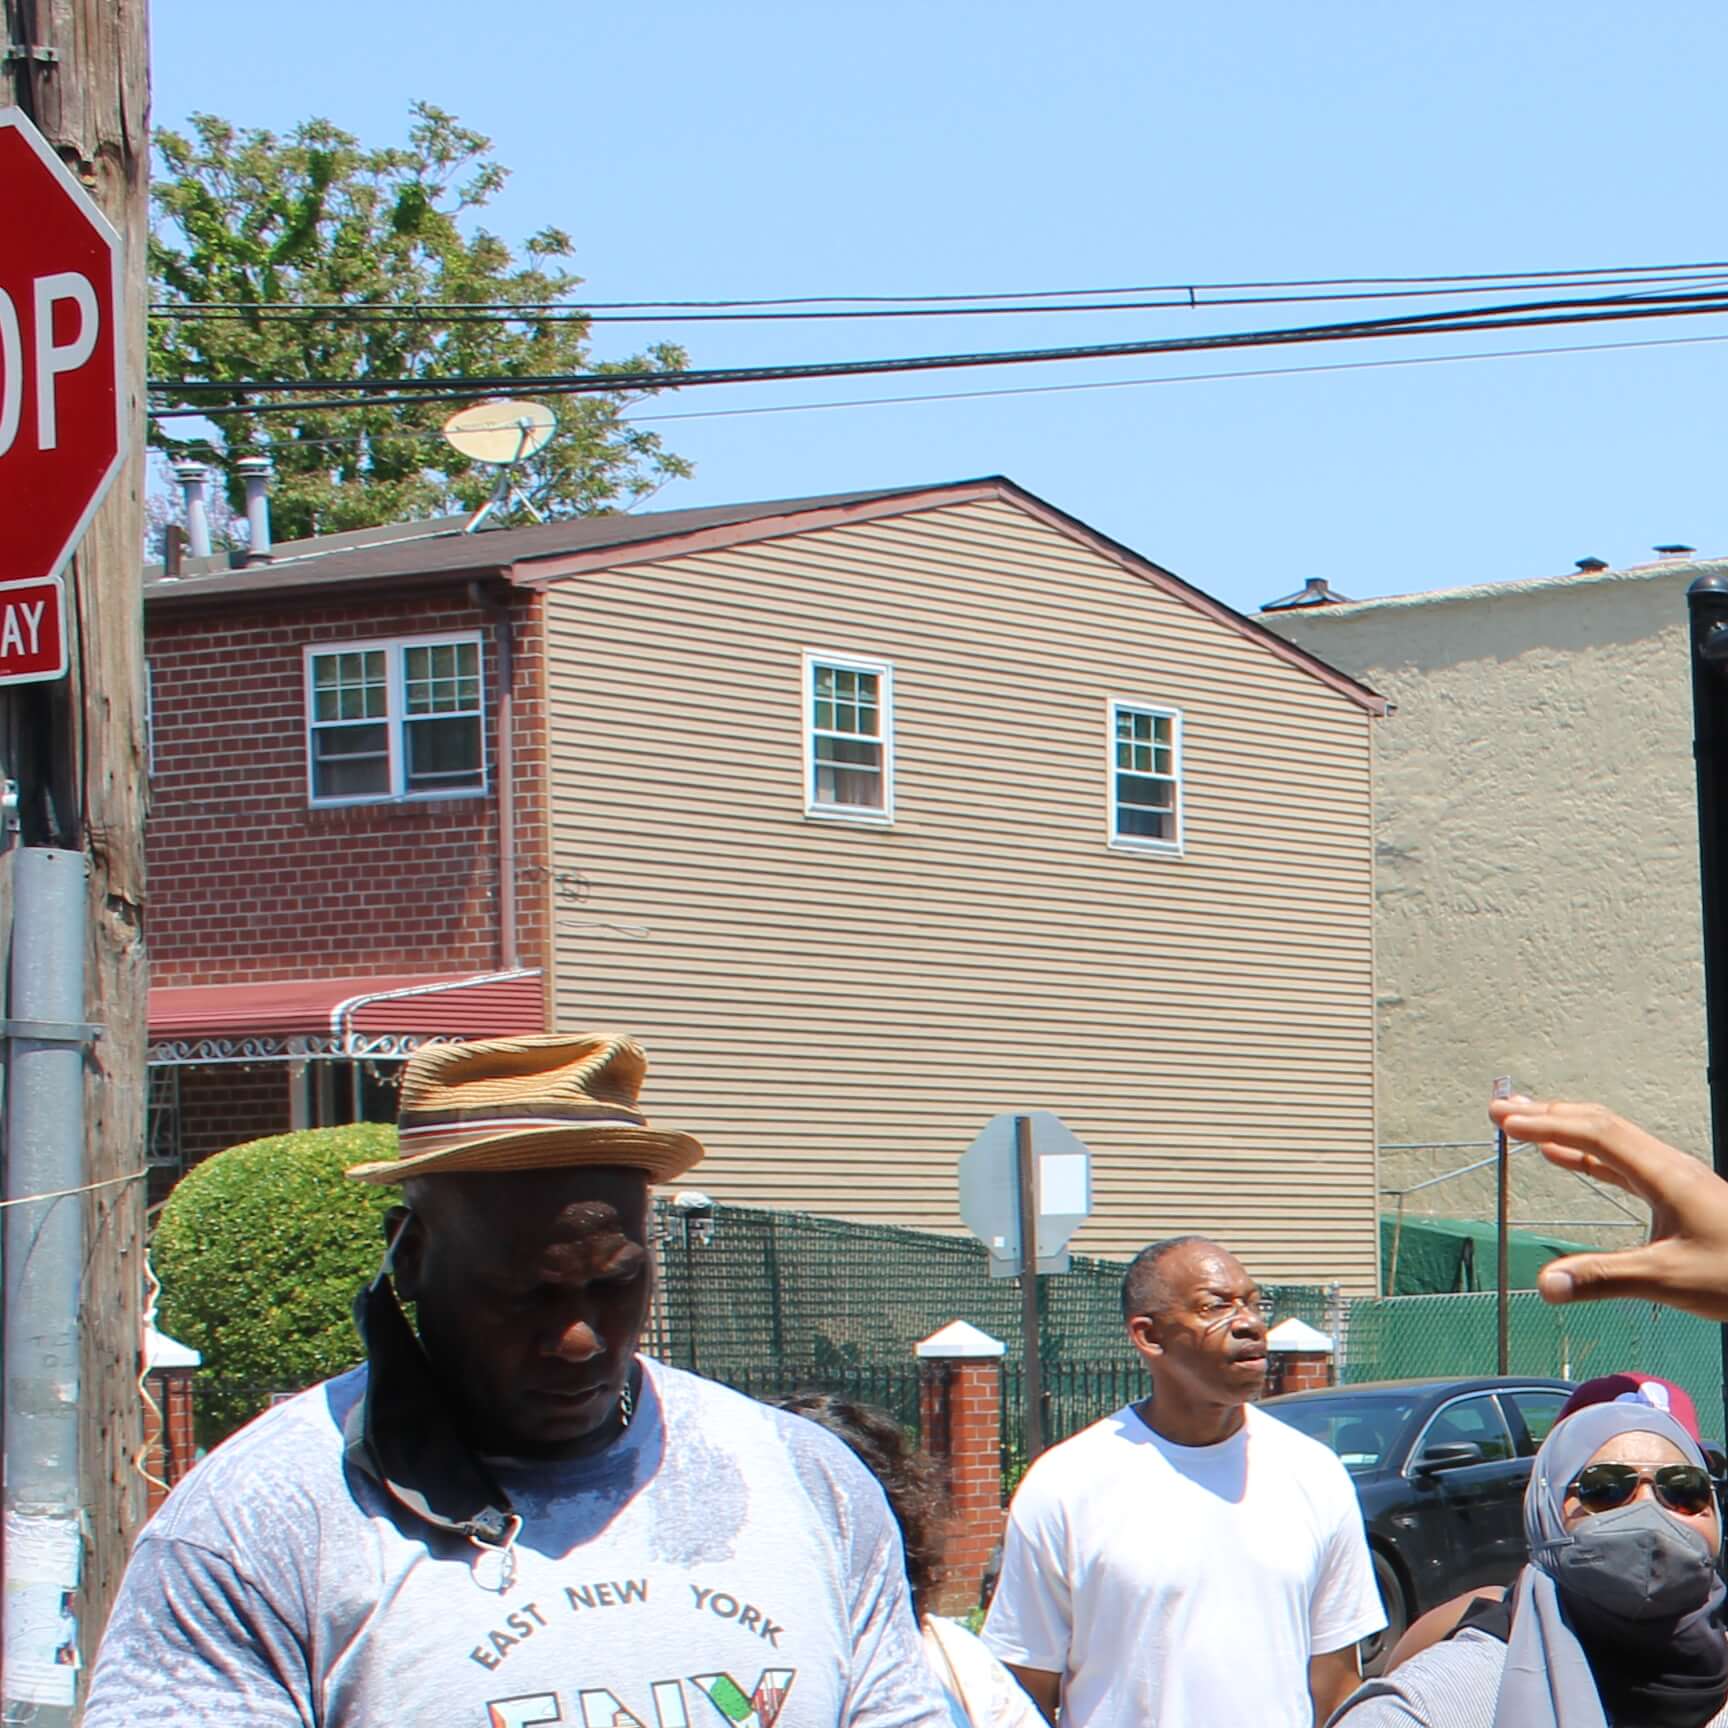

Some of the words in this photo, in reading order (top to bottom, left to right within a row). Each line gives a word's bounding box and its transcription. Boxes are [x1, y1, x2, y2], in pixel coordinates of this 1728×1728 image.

[469, 1602, 548, 1671] EAST
[563, 1579, 651, 1611] NEW
[688, 1584, 784, 1649] YORK
